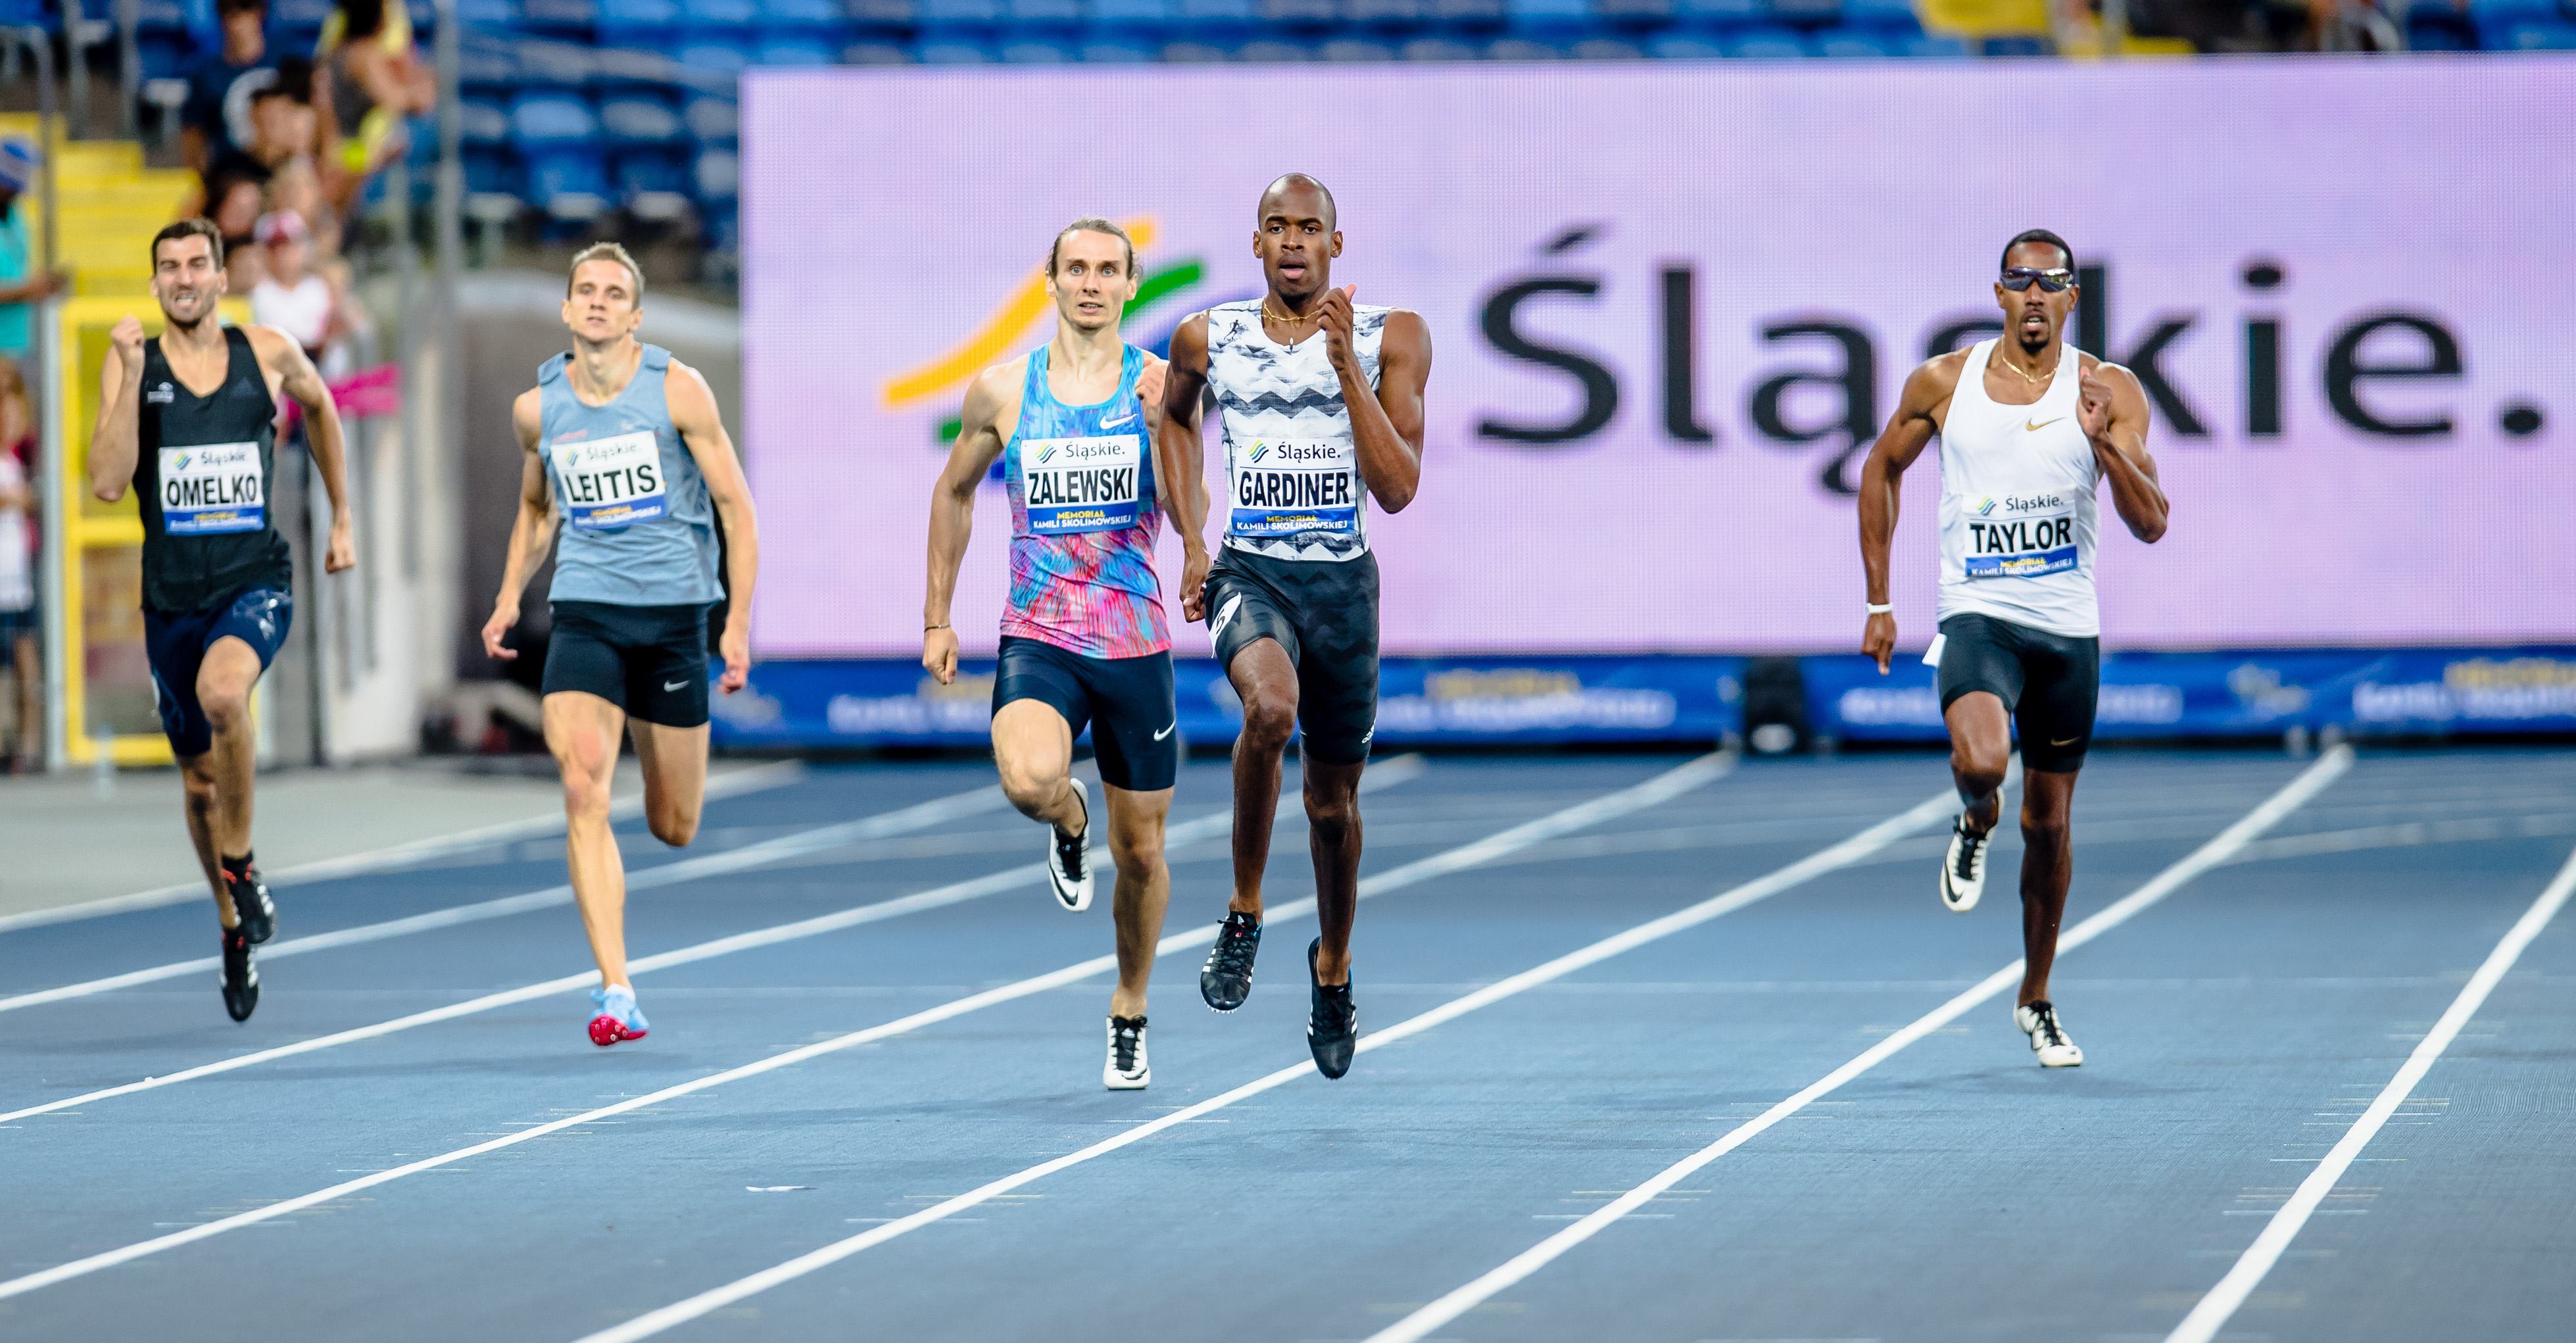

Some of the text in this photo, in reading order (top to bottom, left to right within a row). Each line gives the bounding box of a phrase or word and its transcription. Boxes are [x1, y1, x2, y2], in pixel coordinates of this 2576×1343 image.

[1065, 441, 1125, 460] Śląskie.
[1278, 441, 1341, 463] Śląskie.
[167, 474, 257, 506] OMELKO
[564, 464, 656, 502] LEITIS
[1029, 467, 1133, 504] ZALEWSKI
[1240, 470, 1349, 506] GARDINER
[2005, 495, 2064, 512] Śląskie.
[1033, 514, 1131, 529] KAMILI SKOLIMOWSKIEJ
[1057, 510, 1106, 520] MEMORIAŁ
[1237, 520, 1348, 531] KAMILI SKOLIMOWSKIEJ
[1969, 516, 2072, 553] TAYLOR
